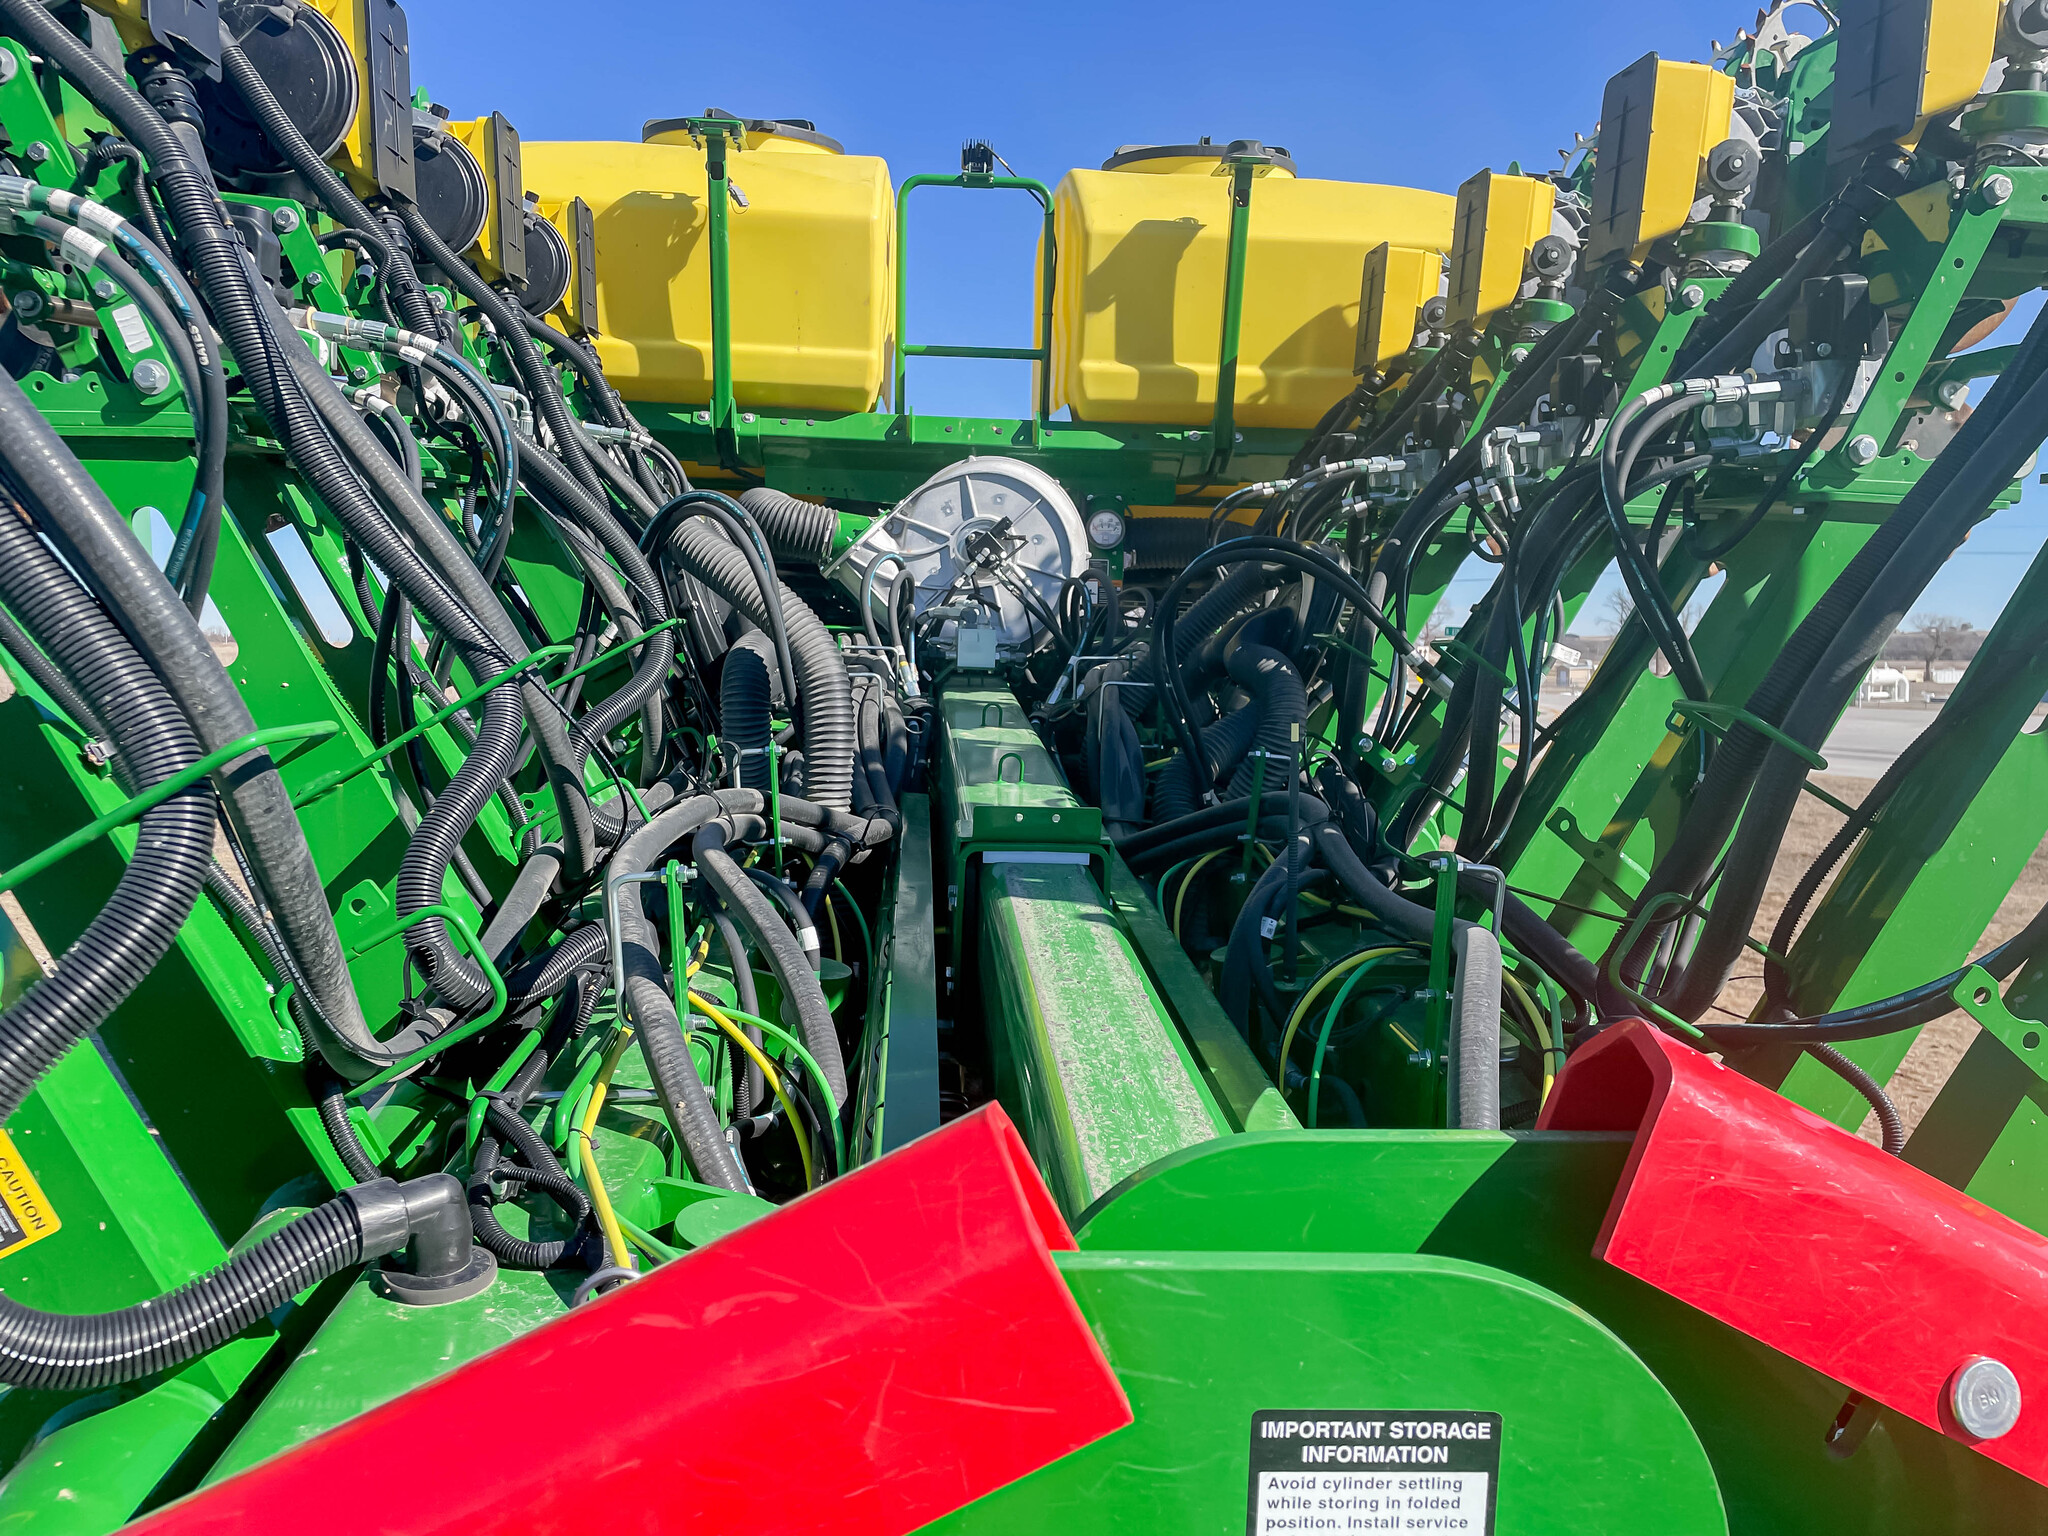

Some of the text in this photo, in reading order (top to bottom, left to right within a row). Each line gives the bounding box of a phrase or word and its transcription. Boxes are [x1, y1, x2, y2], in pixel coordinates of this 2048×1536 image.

[189, 324, 210, 366] GATES
[0, 1157, 46, 1231] CAUTION
[1261, 1421, 1491, 1440] IMPORTANT STORAGE
[1301, 1445, 1449, 1463] INFORMATION
[1267, 1477, 1464, 1492] Avoid cylinder settling
[1266, 1496, 1461, 1512] while storing in folded
[1265, 1516, 1469, 1531] position. Install service
